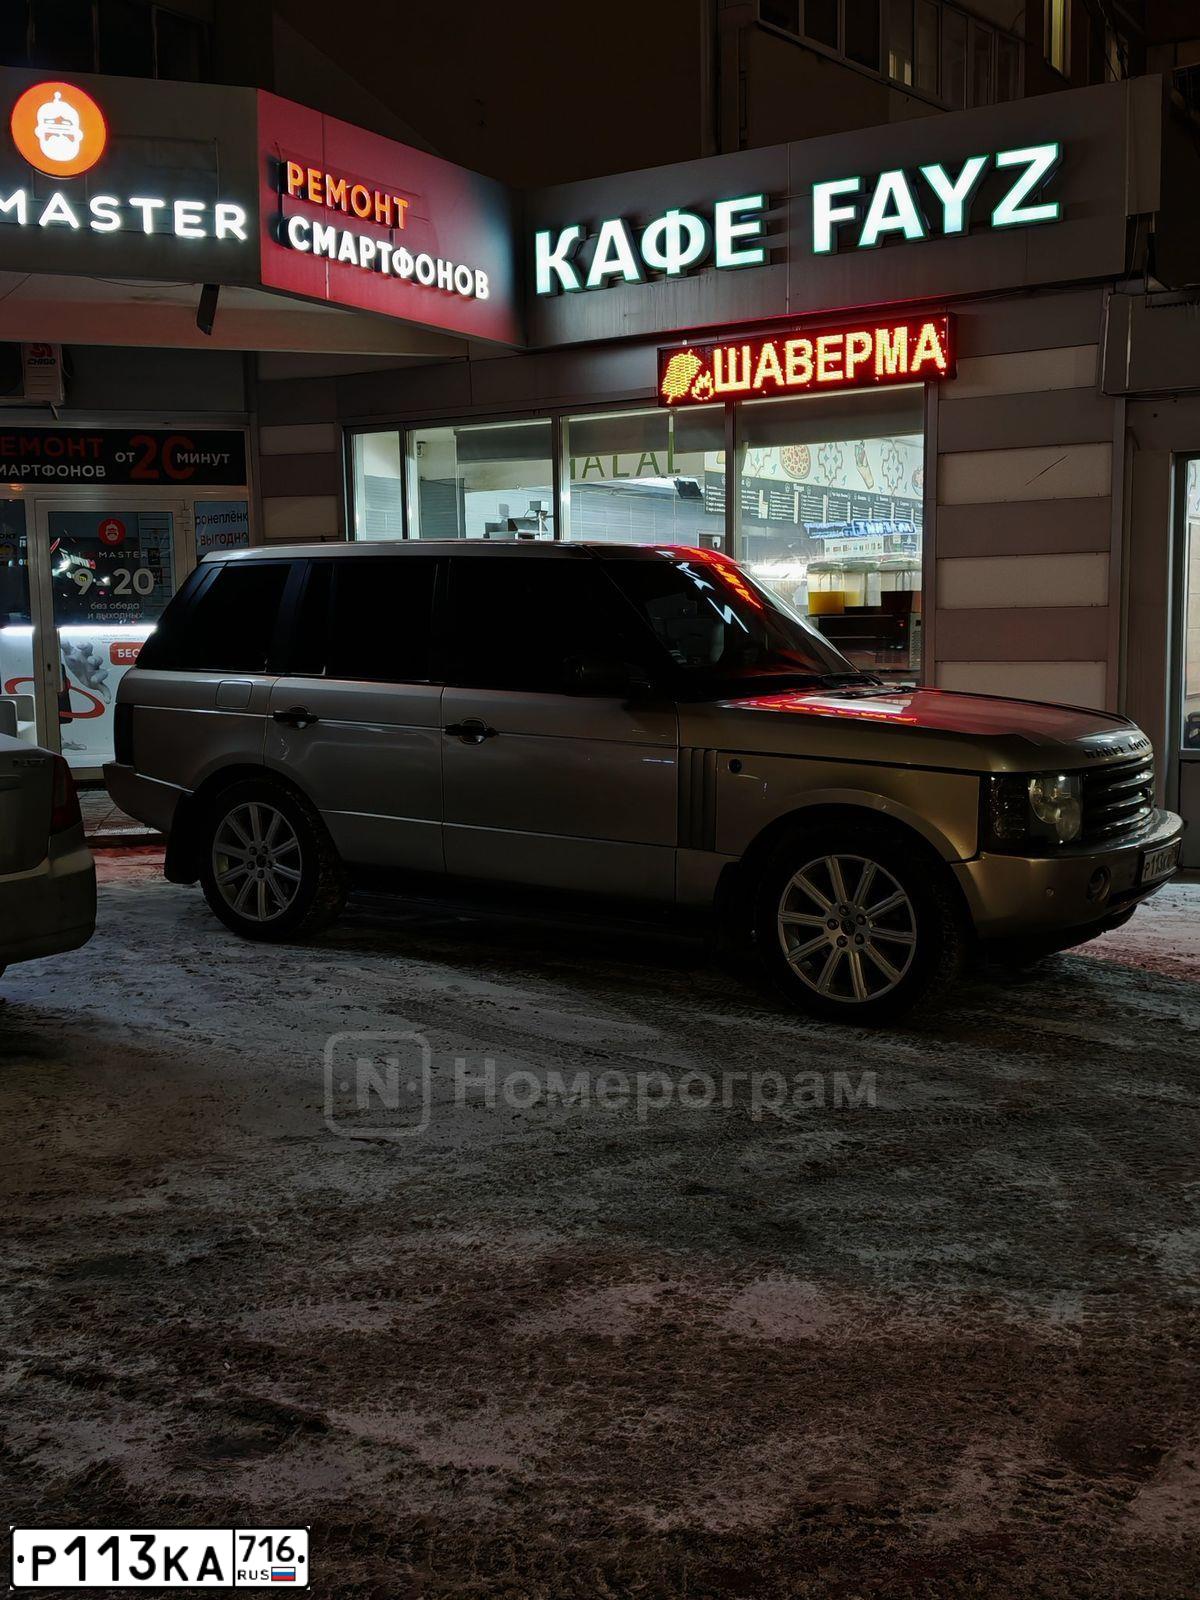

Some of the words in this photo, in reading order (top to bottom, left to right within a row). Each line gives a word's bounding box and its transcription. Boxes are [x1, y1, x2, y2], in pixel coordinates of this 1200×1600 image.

[0, 189, 247, 240] MASTER
[286, 160, 409, 230] РЕМОНТ
[535, 193, 766, 295] КАФЕ
[811, 142, 1061, 255] FAYZ
[288, 215, 490, 300] СМАРТФОНОВ
[713, 322, 947, 393] ШАВЕРМА
[115, 451, 136, 463] от
[177, 452, 230, 466] минут
